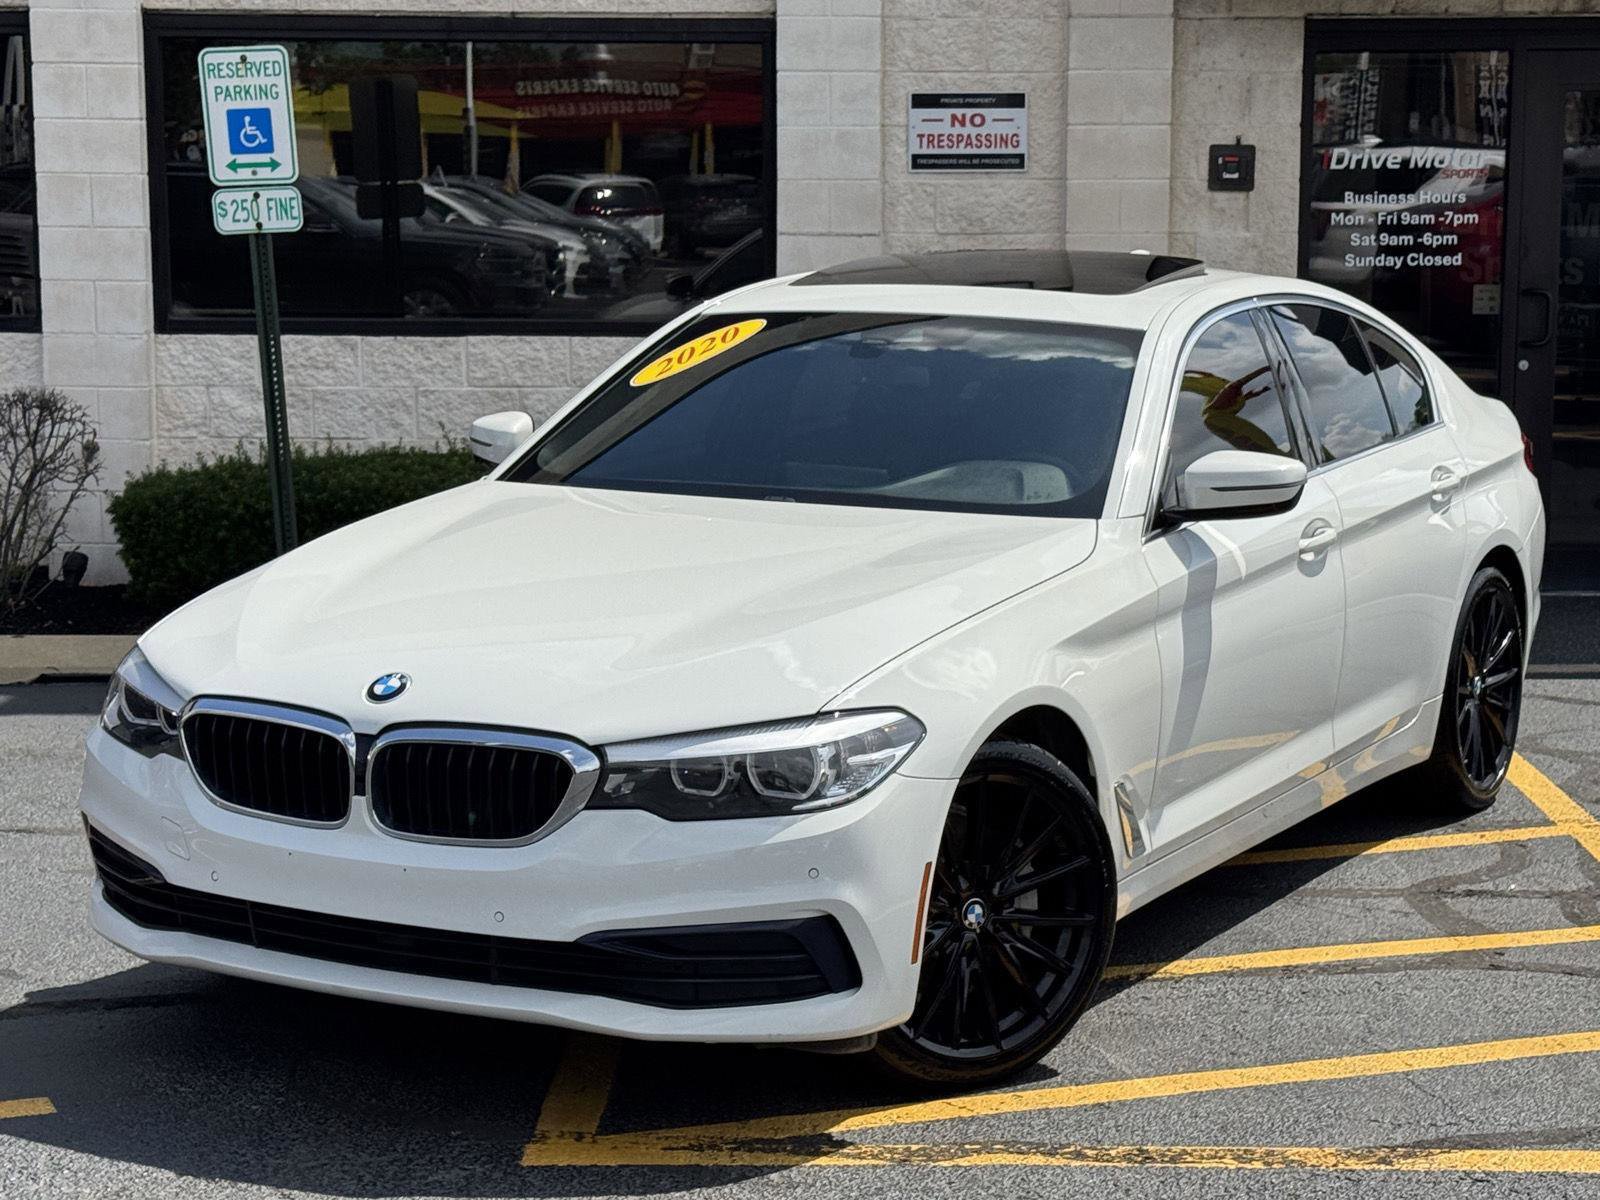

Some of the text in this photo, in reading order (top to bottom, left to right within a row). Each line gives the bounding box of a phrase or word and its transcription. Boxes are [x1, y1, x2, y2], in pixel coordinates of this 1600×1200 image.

[207, 61, 281, 79] RESERVED
[214, 83, 279, 102] PARKING
[950, 113, 986, 128] NO
[916, 133, 1020, 149] TRESPASSING
[1409, 147, 1489, 169] Motor
[1441, 168, 1489, 179] SPORTS
[1344, 191, 1467, 204] Business Hours
[266, 197, 299, 221] FINE
[1330, 212, 1364, 226] Mon
[1378, 212, 1398, 225] Fri
[1400, 212, 1435, 225] 9am
[1438, 212, 1479, 228] -7pm
[1350, 233, 1458, 249] Sat 9am -6pm
[1344, 253, 1463, 270] Sunday Closed
[655, 326, 740, 378] 2020
